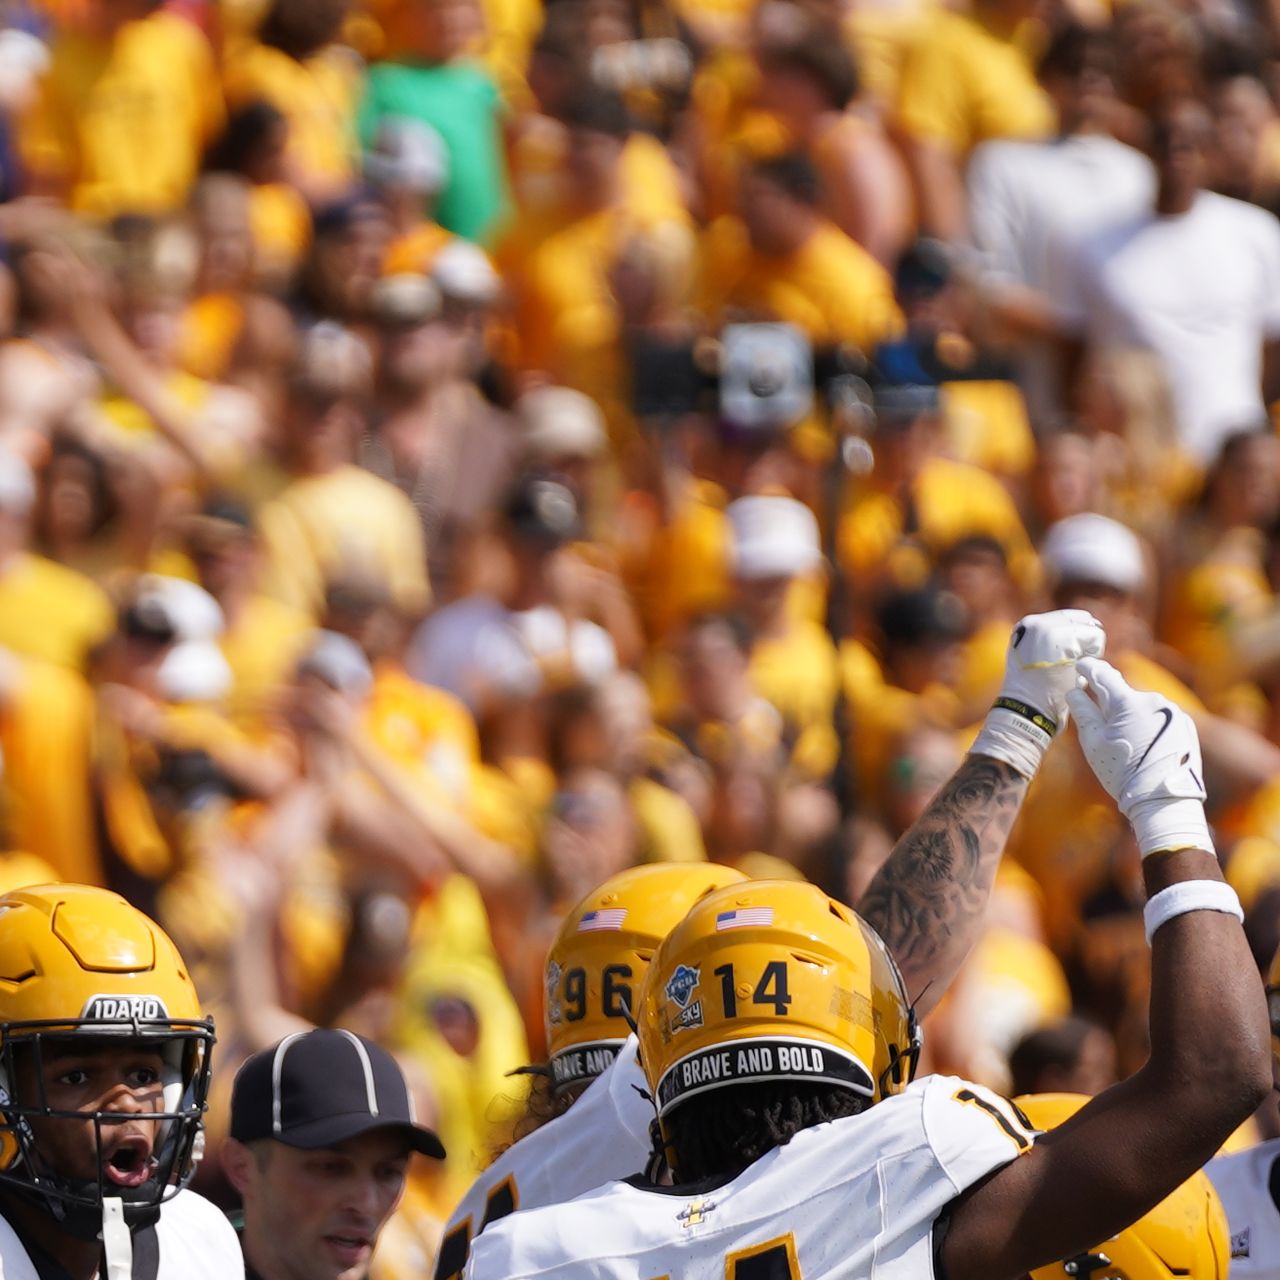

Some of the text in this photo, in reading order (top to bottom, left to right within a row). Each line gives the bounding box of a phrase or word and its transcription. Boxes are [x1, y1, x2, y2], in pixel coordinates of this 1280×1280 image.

[94, 999, 159, 1020] IDAHO
[565, 963, 633, 1022] 96
[713, 960, 792, 1018] 14
[682, 1046, 825, 1087] BRAVE AND BOLD
